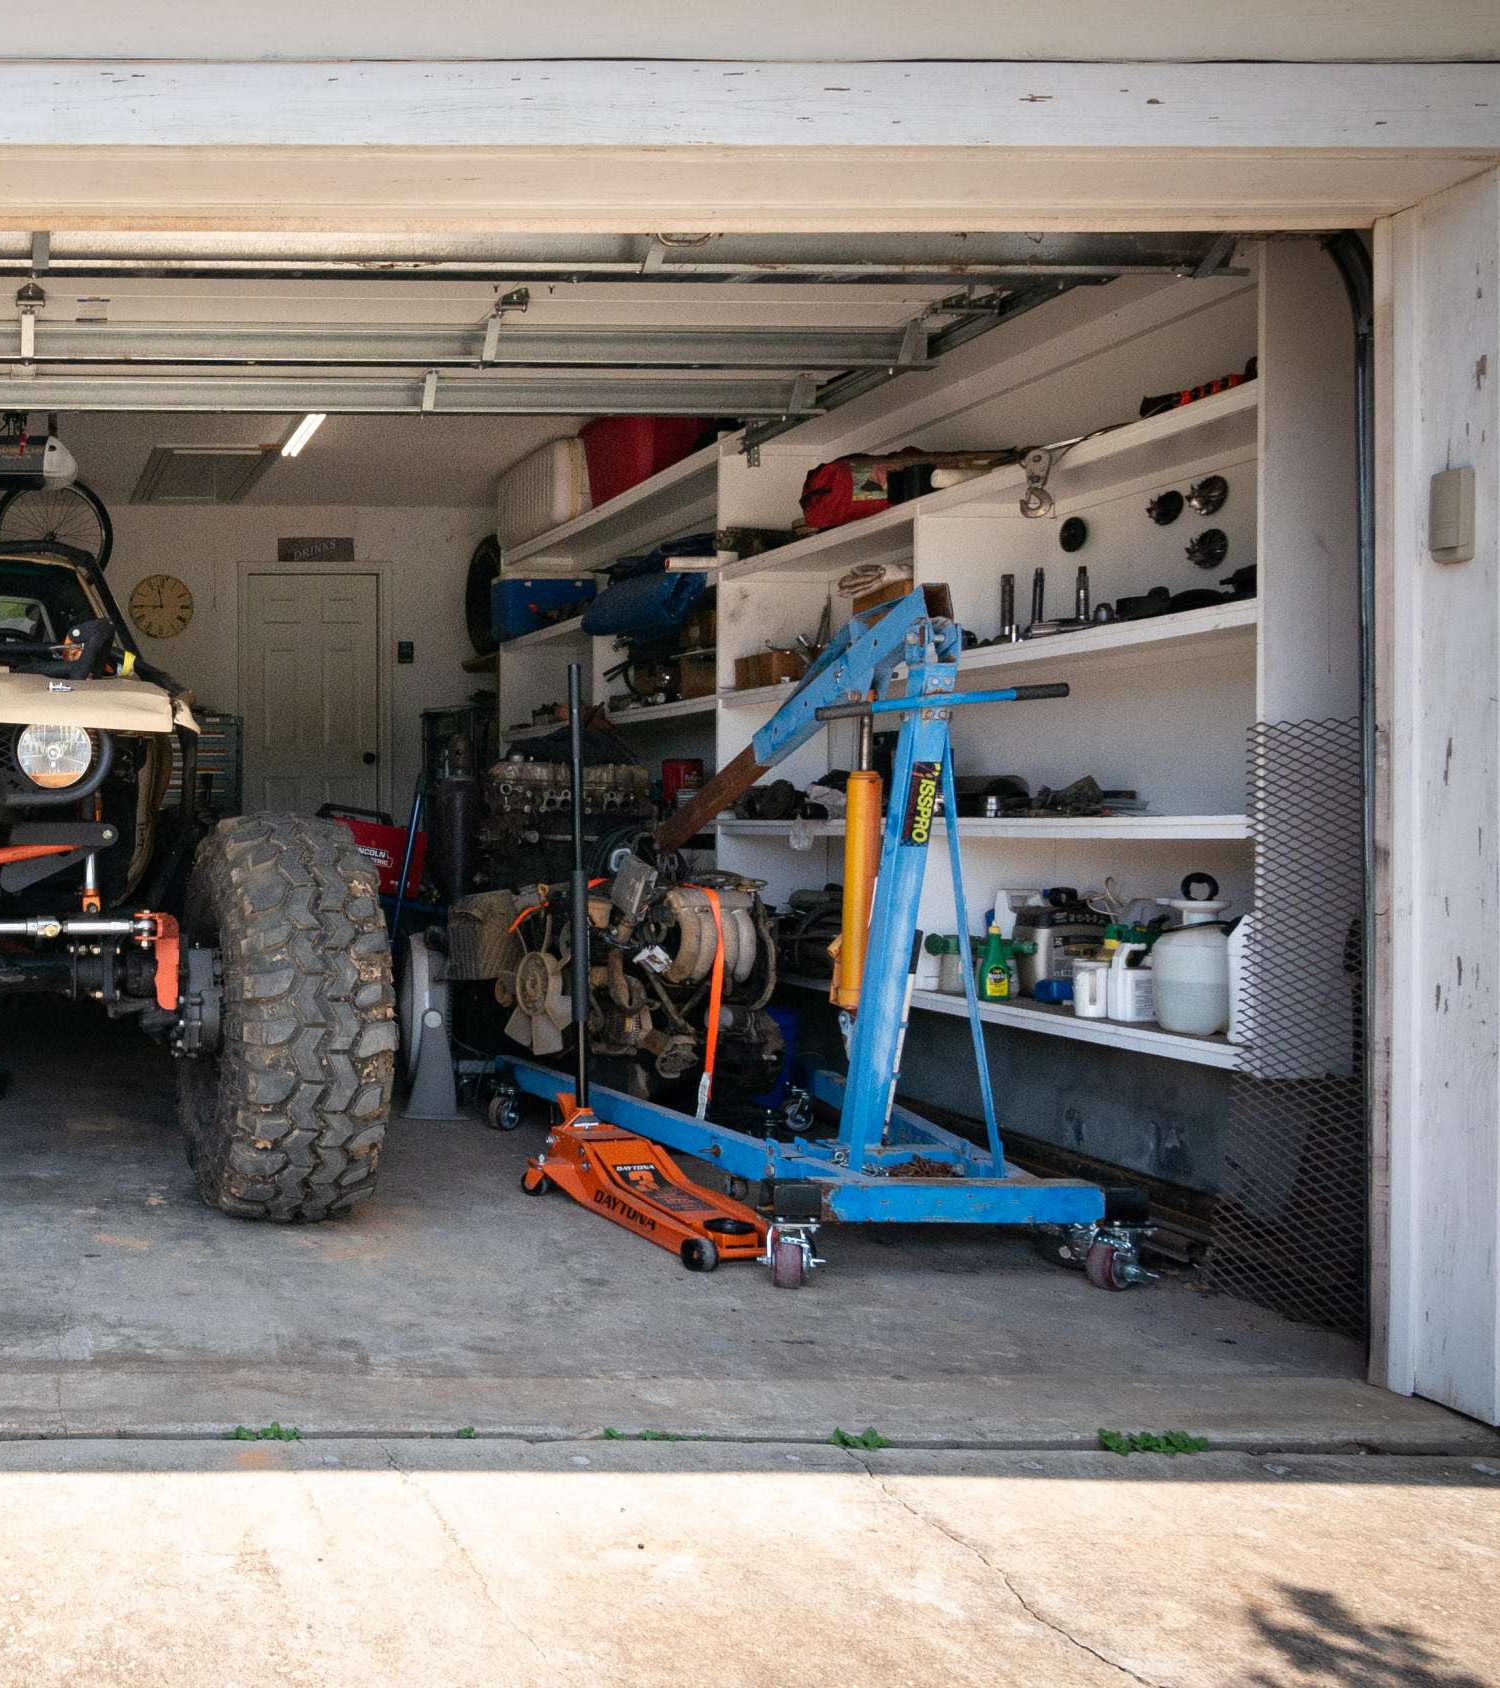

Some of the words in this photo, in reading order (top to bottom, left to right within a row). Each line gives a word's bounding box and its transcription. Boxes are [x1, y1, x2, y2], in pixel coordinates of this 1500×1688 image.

[294, 538, 336, 561] DRINKS
[911, 779, 937, 843] ISSPRO
[356, 846, 386, 858] NCOLN
[616, 1164, 656, 1172] DAYTONA
[628, 1170, 660, 1192] 3
[593, 1189, 657, 1231] DAYTONA
